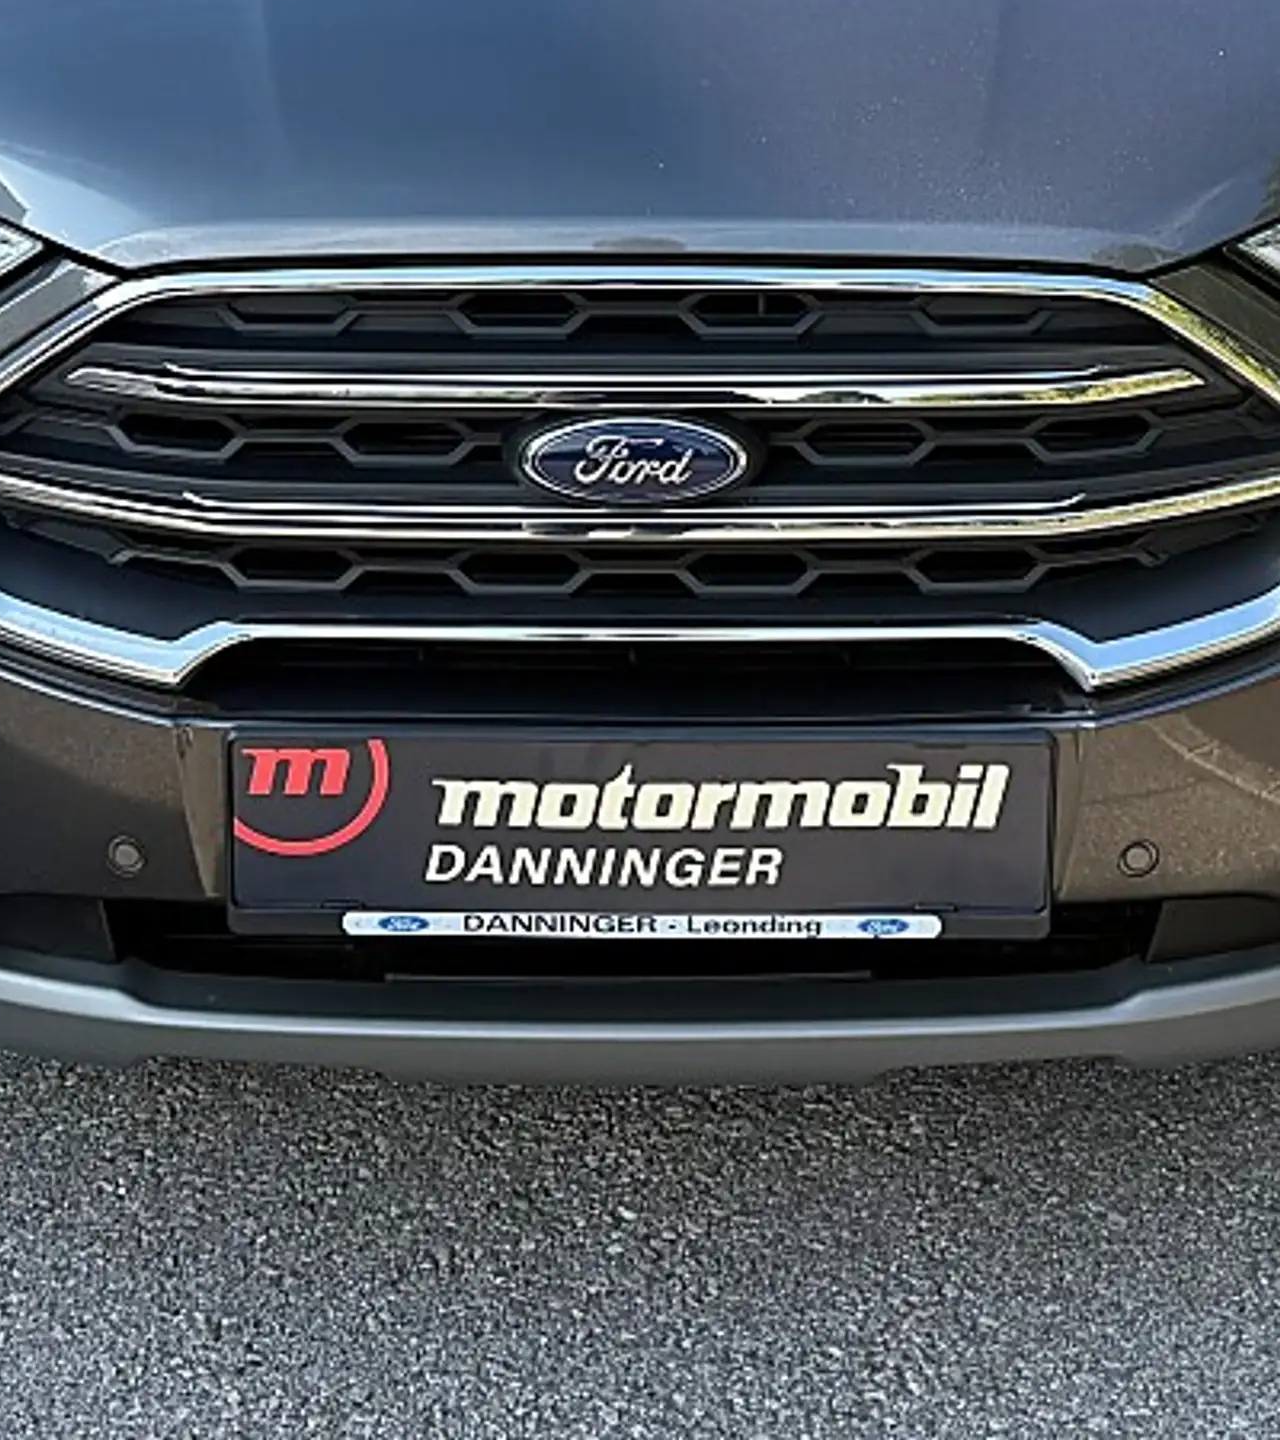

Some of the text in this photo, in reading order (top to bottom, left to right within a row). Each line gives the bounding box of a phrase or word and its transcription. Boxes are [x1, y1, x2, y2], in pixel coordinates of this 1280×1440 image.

[574, 434, 693, 484] Ford
[431, 763, 1010, 830] motormobil
[424, 844, 784, 886] DANNINGER
[463, 914, 657, 933] DANNINGER
[687, 915, 822, 937] Leonding
